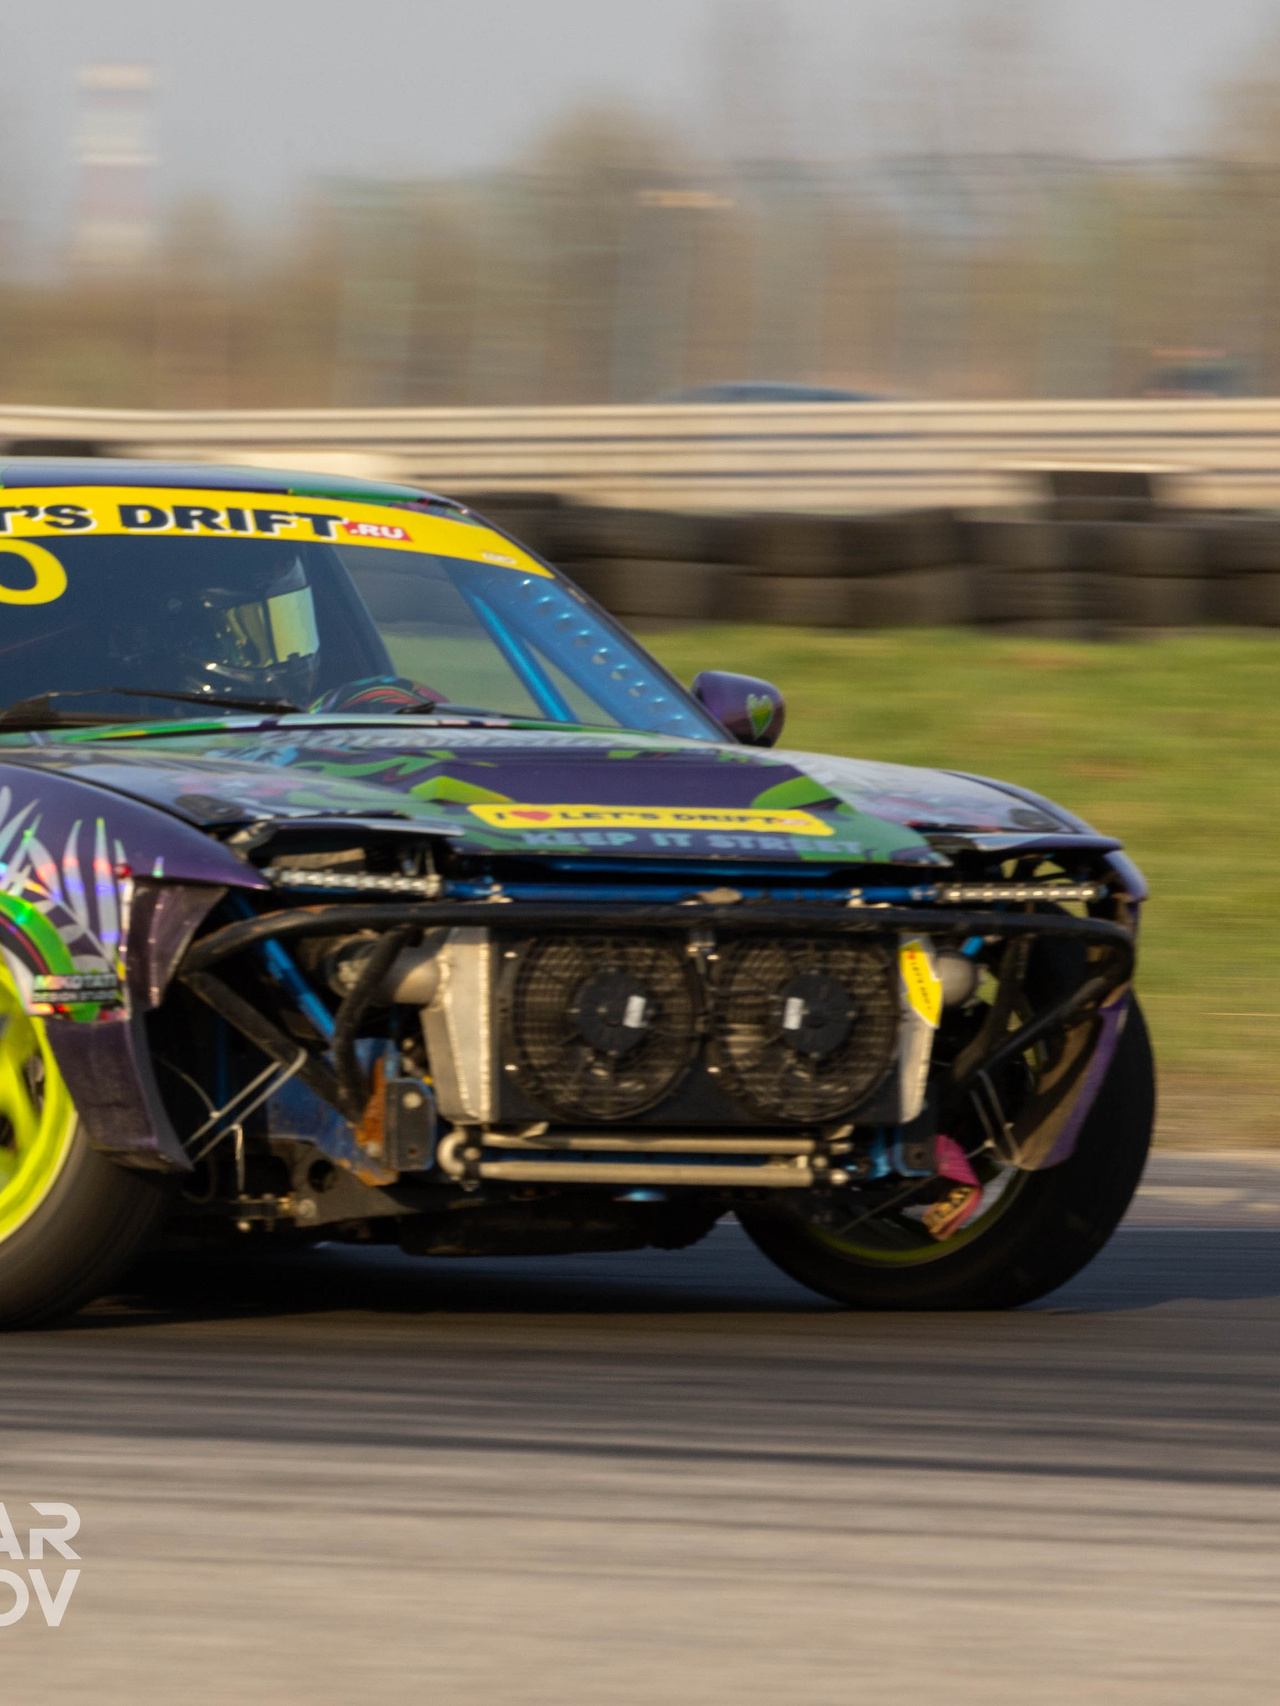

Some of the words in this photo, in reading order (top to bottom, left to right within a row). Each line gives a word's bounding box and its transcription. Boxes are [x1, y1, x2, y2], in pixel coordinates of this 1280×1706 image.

[521, 832, 637, 846] KEEP
[650, 832, 693, 847] IT
[706, 833, 862, 854] STREET
